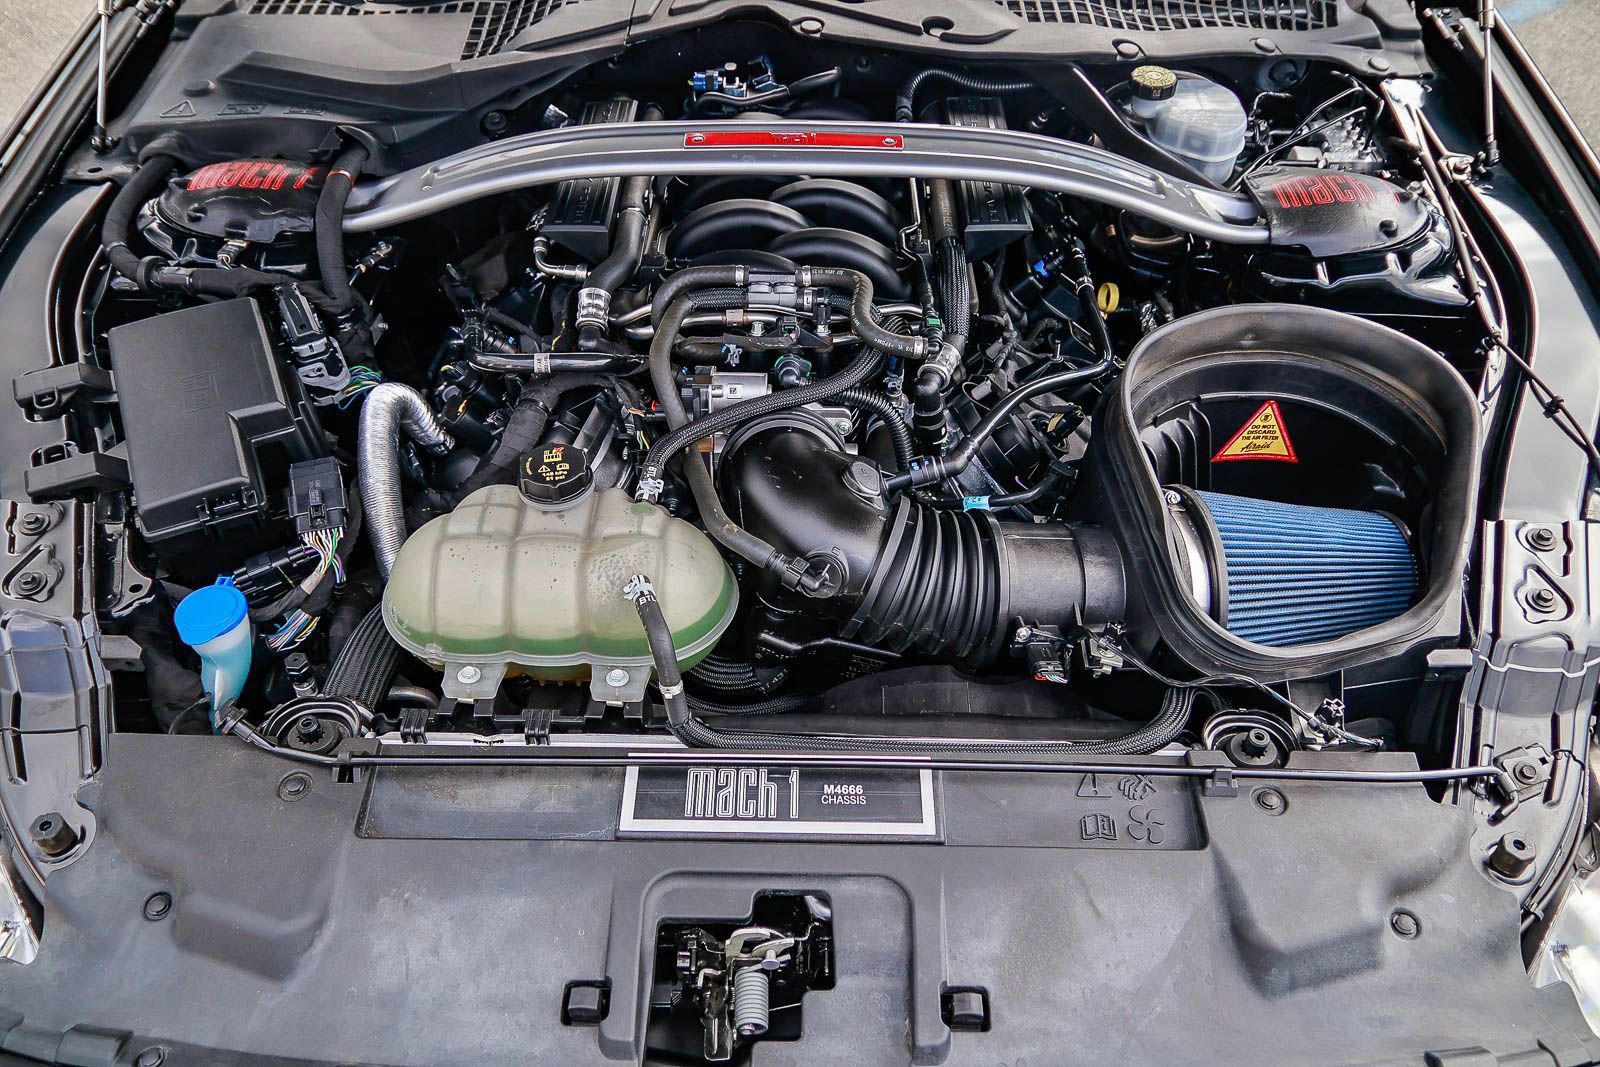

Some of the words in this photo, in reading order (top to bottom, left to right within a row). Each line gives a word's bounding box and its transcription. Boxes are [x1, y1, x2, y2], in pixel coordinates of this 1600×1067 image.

[639, 595, 656, 605] BTL
[685, 769, 777, 817] mach
[789, 769, 799, 818] 1
[823, 784, 863, 794] M4666
[821, 795, 867, 805] CHASSIS
